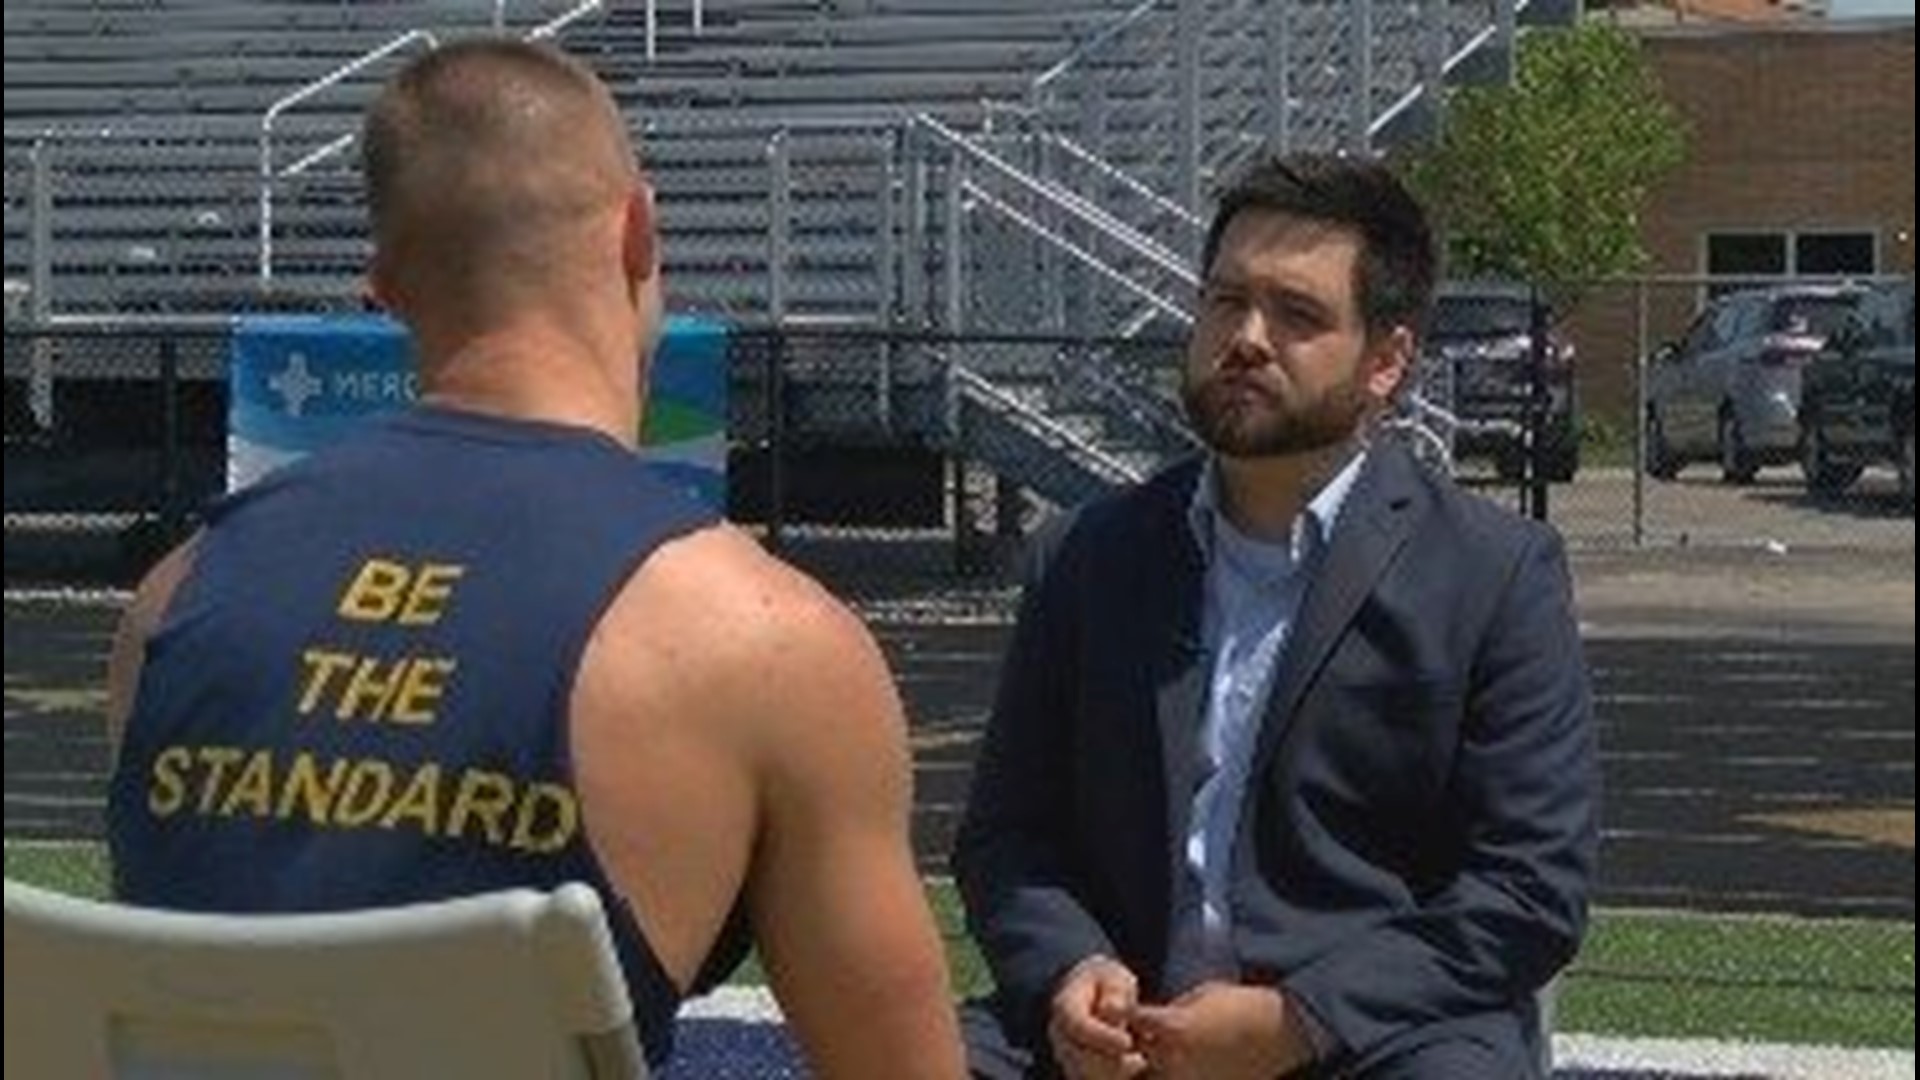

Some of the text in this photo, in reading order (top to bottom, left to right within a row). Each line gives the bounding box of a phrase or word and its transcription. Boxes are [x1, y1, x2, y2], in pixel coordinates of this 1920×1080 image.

[337, 558, 465, 625] BE
[299, 650, 457, 724] THE
[148, 746, 578, 853] STANDARD
